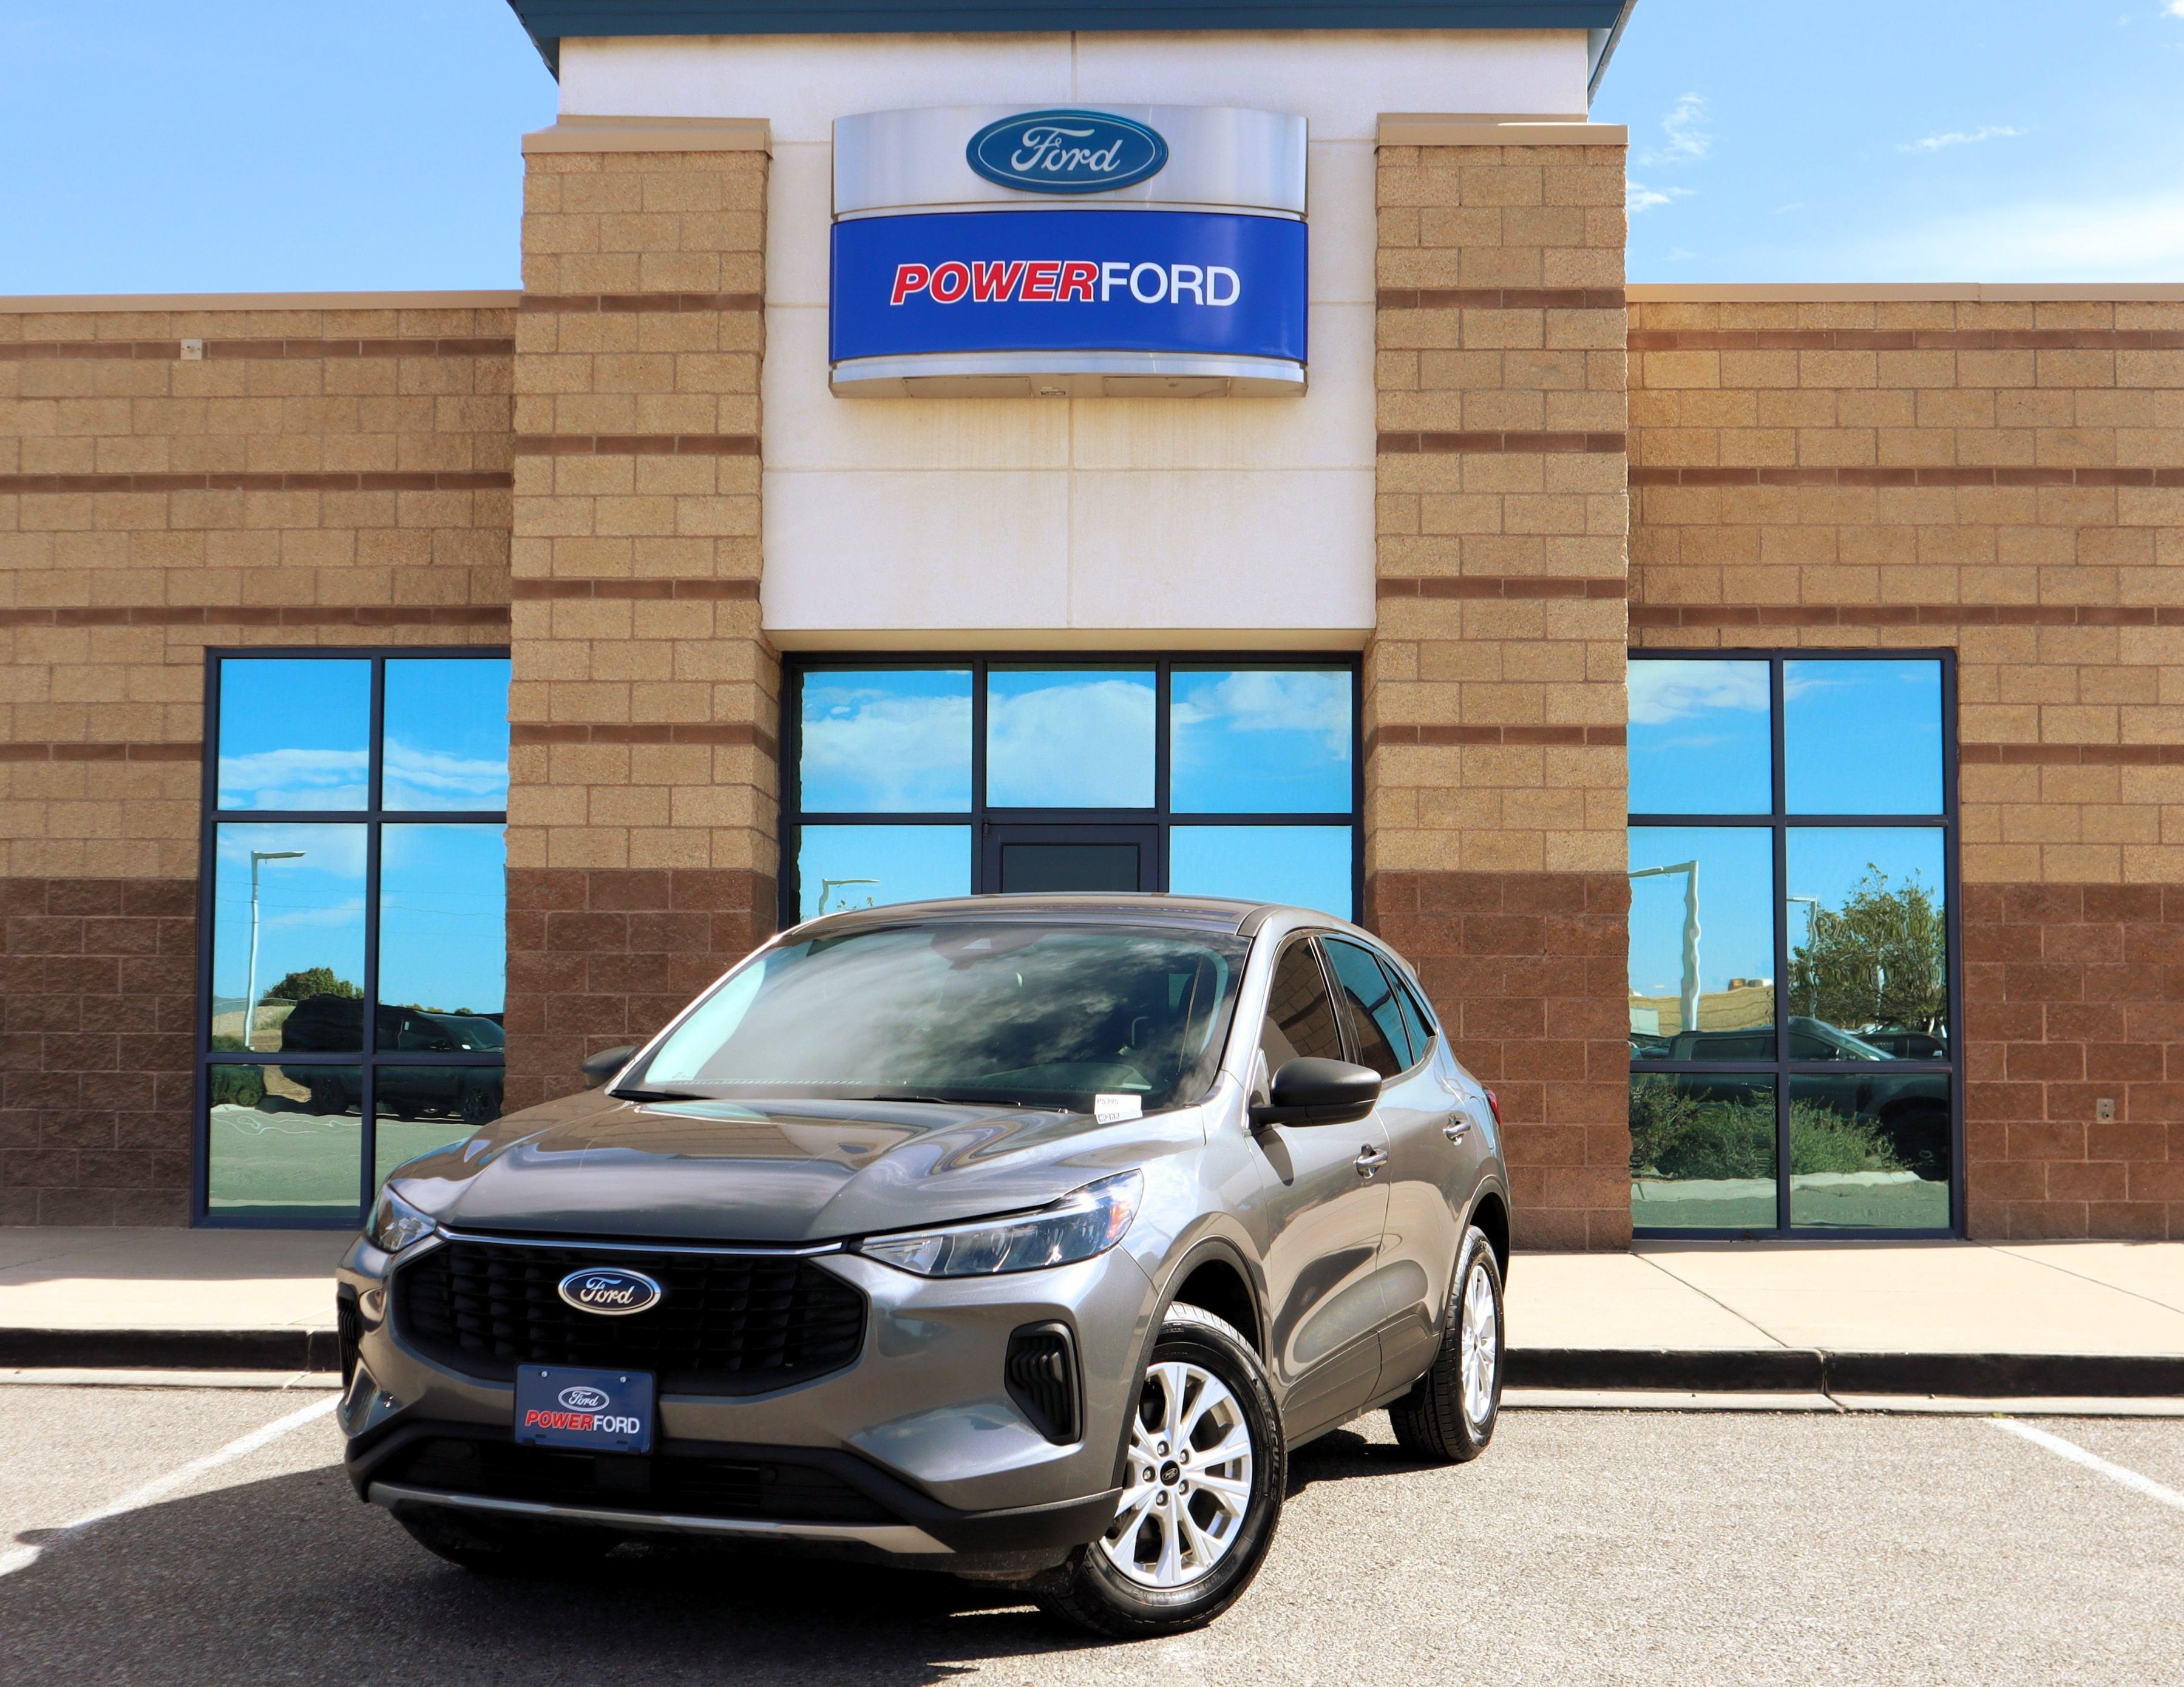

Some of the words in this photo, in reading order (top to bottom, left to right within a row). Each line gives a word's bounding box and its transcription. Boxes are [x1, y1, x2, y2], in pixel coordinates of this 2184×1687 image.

[1011, 125, 1123, 172] Ford
[890, 260, 1241, 306] POWERFORD
[579, 1277, 636, 1305] Ford
[568, 1391, 599, 1407] Ford
[524, 1410, 640, 1434] POWERFORD
